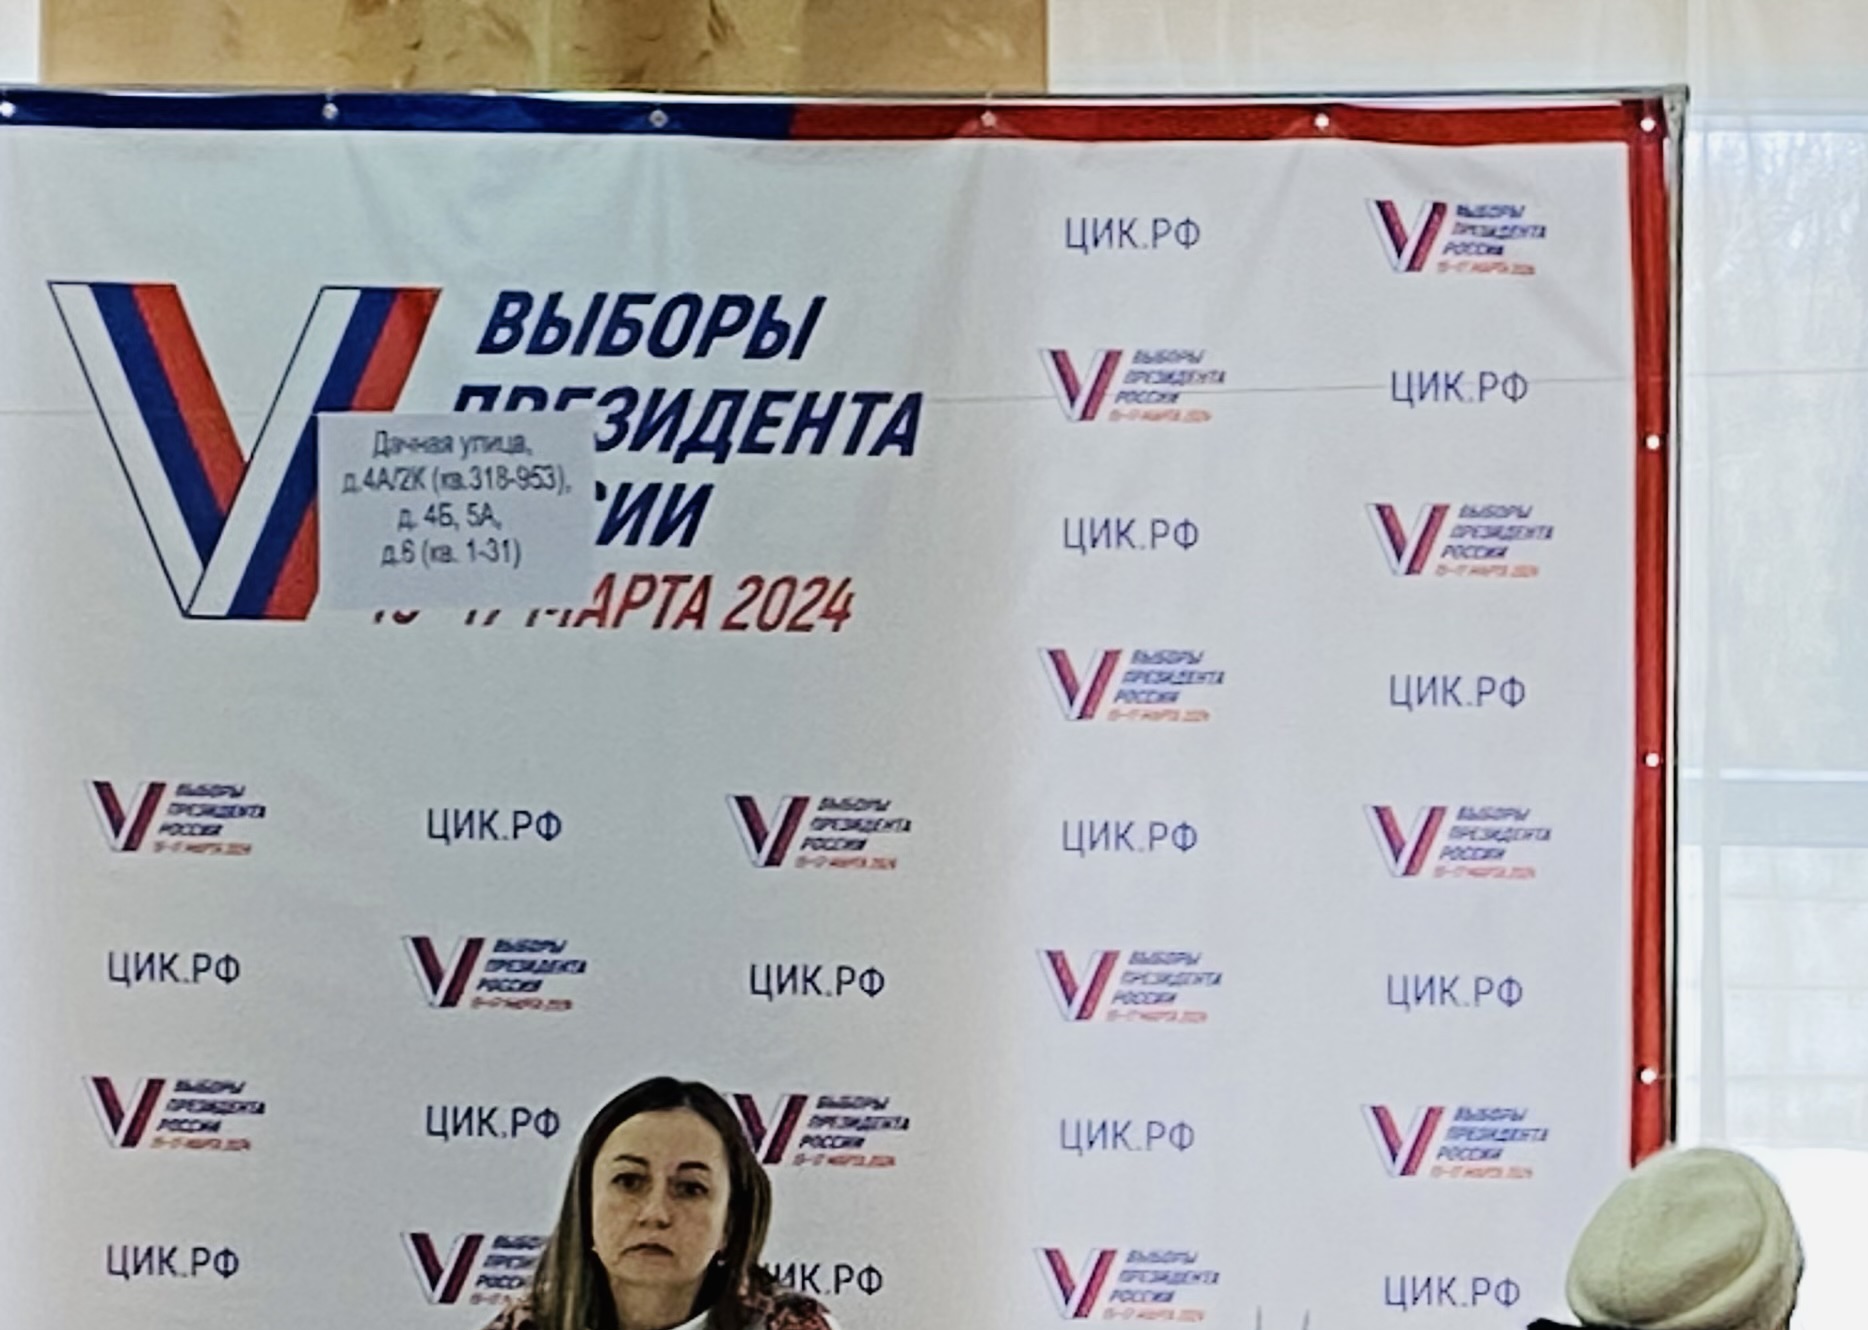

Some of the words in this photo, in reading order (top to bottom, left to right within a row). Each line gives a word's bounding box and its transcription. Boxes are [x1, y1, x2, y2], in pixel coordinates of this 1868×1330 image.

[1065, 217, 1200, 255] ЦИК.РФ
[477, 290, 827, 360] ВЫБОРЫ
[1391, 370, 1529, 409] ЦИК.РФ
[372, 430, 453, 458] Дачная
[460, 433, 533, 459] улица,
[466, 537, 522, 570] 1-31)
[1064, 517, 1199, 556] ЦИК.РФ
[525, 573, 714, 631] АРТА
[721, 575, 855, 632] 2024
[1390, 675, 1525, 712] ЦИК.РФ
[427, 808, 562, 846] ЦИК.РФ
[1063, 820, 1197, 858] ЦИК.РФ
[108, 951, 240, 988] ЦИК.РФ
[750, 963, 885, 1002] ЦИК.РФ
[1387, 974, 1523, 1012] ЦИК.РФ
[426, 1105, 561, 1143] ЦИК.РФ
[1060, 1119, 1194, 1157] ЦИК.РФ
[107, 1245, 240, 1281] ЦИК.РФ
[766, 1262, 883, 1295] ИК.РФ
[1385, 1275, 1520, 1312] ЦИК.РФ
